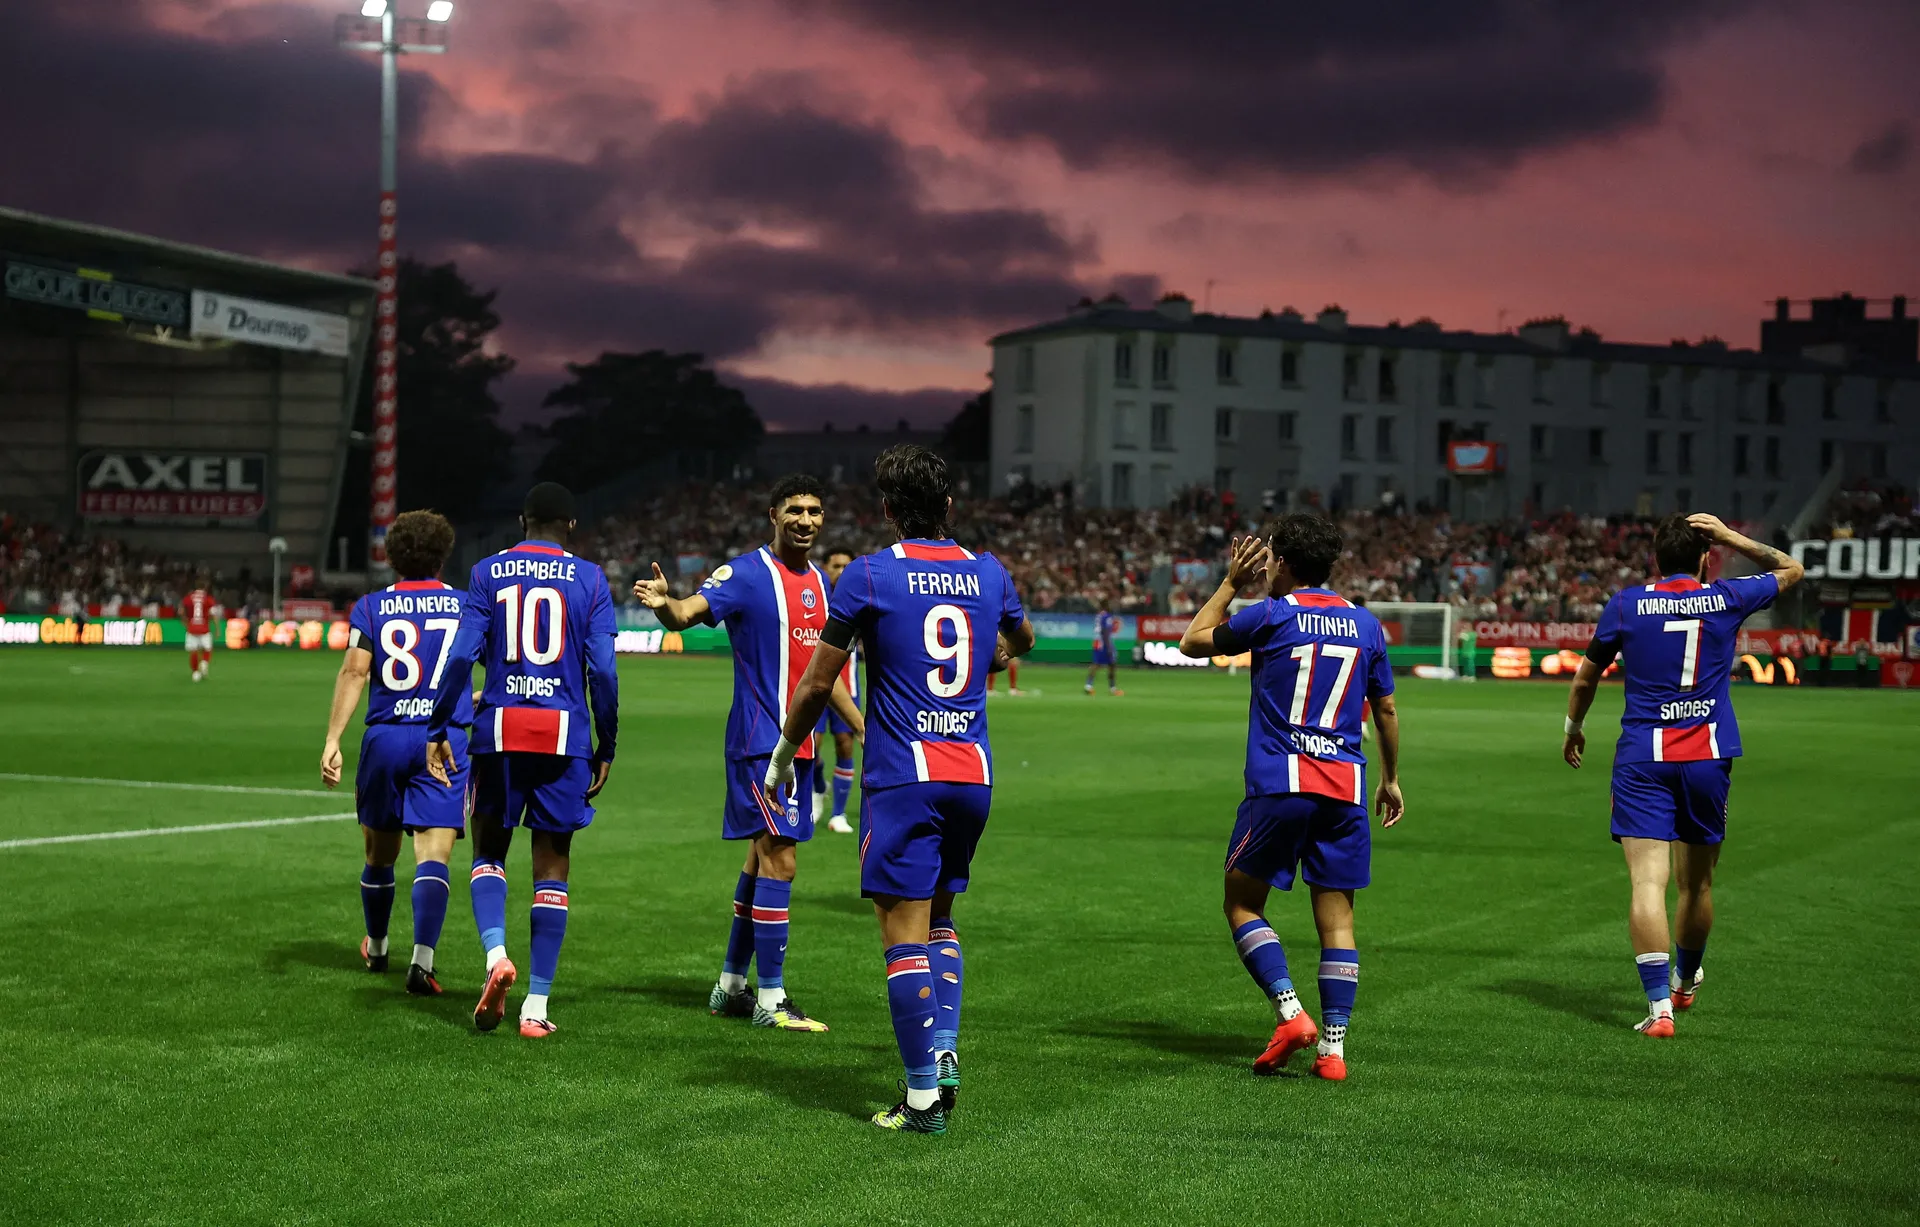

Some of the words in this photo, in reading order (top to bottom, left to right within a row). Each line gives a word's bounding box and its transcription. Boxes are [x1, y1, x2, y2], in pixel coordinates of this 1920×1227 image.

[87, 454, 258, 492] AXEL
[491, 559, 576, 582] O.DEMBÉLÉ
[907, 572, 981, 596] FERRAN
[379, 595, 414, 615] JOÃO
[416, 596, 460, 614] NEVES
[1637, 594, 1727, 616] KVARATSKHELIA
[496, 584, 567, 666] 10
[792, 627, 823, 641] QATA
[1296, 612, 1359, 639] VITINHA
[380, 618, 460, 692] 87
[923, 604, 973, 698] 9
[1663, 619, 1704, 692] 7
[506, 674, 556, 699] snipes
[1289, 642, 1362, 729] 17
[1660, 699, 1711, 720] snipes
[917, 710, 969, 737] snipes
[544, 895, 561, 903] PARIS
